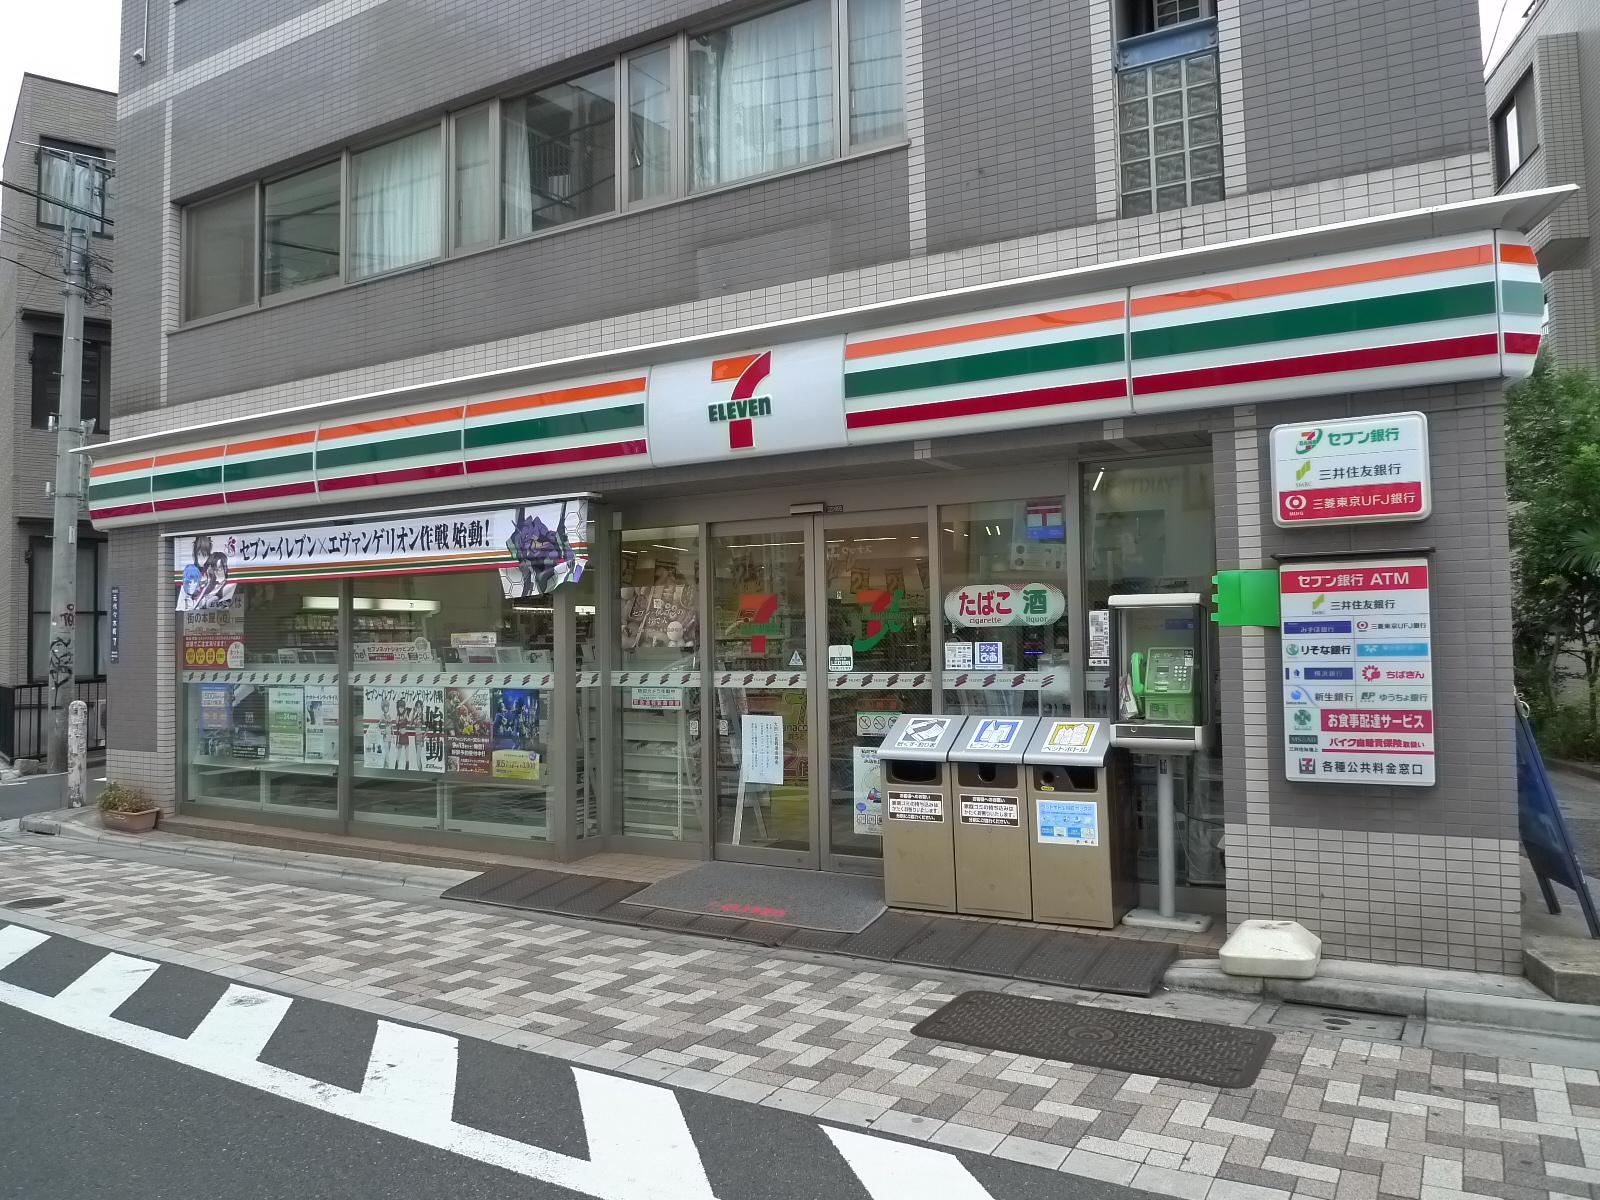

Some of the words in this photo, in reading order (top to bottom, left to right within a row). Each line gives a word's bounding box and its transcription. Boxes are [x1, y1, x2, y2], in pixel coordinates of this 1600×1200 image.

[1327, 427, 1400, 446] セブン銀行
[1319, 463, 1402, 481] 三井住友銀行
[1313, 492, 1416, 510] 三菱東京UFJ銀行
[1298, 573, 1364, 588] セブン銀行
[1370, 571, 1410, 586] ATM
[959, 590, 1012, 616] たばこ
[1022, 589, 1048, 614] 酒
[1330, 599, 1396, 611] 三井住友銀行
[969, 616, 1002, 625] cigarette
[1025, 614, 1048, 624] liquor
[1301, 644, 1351, 655] りそな銀行
[980, 652, 998, 663] ぴあ
[1314, 692, 1354, 702] 新生銀行
[1379, 693, 1428, 702] ゆうちょ銀行
[1328, 713, 1424, 729] お食事配達サービス
[783, 724, 808, 732] anaco
[1321, 760, 1424, 775] 各種公共料金窓口
